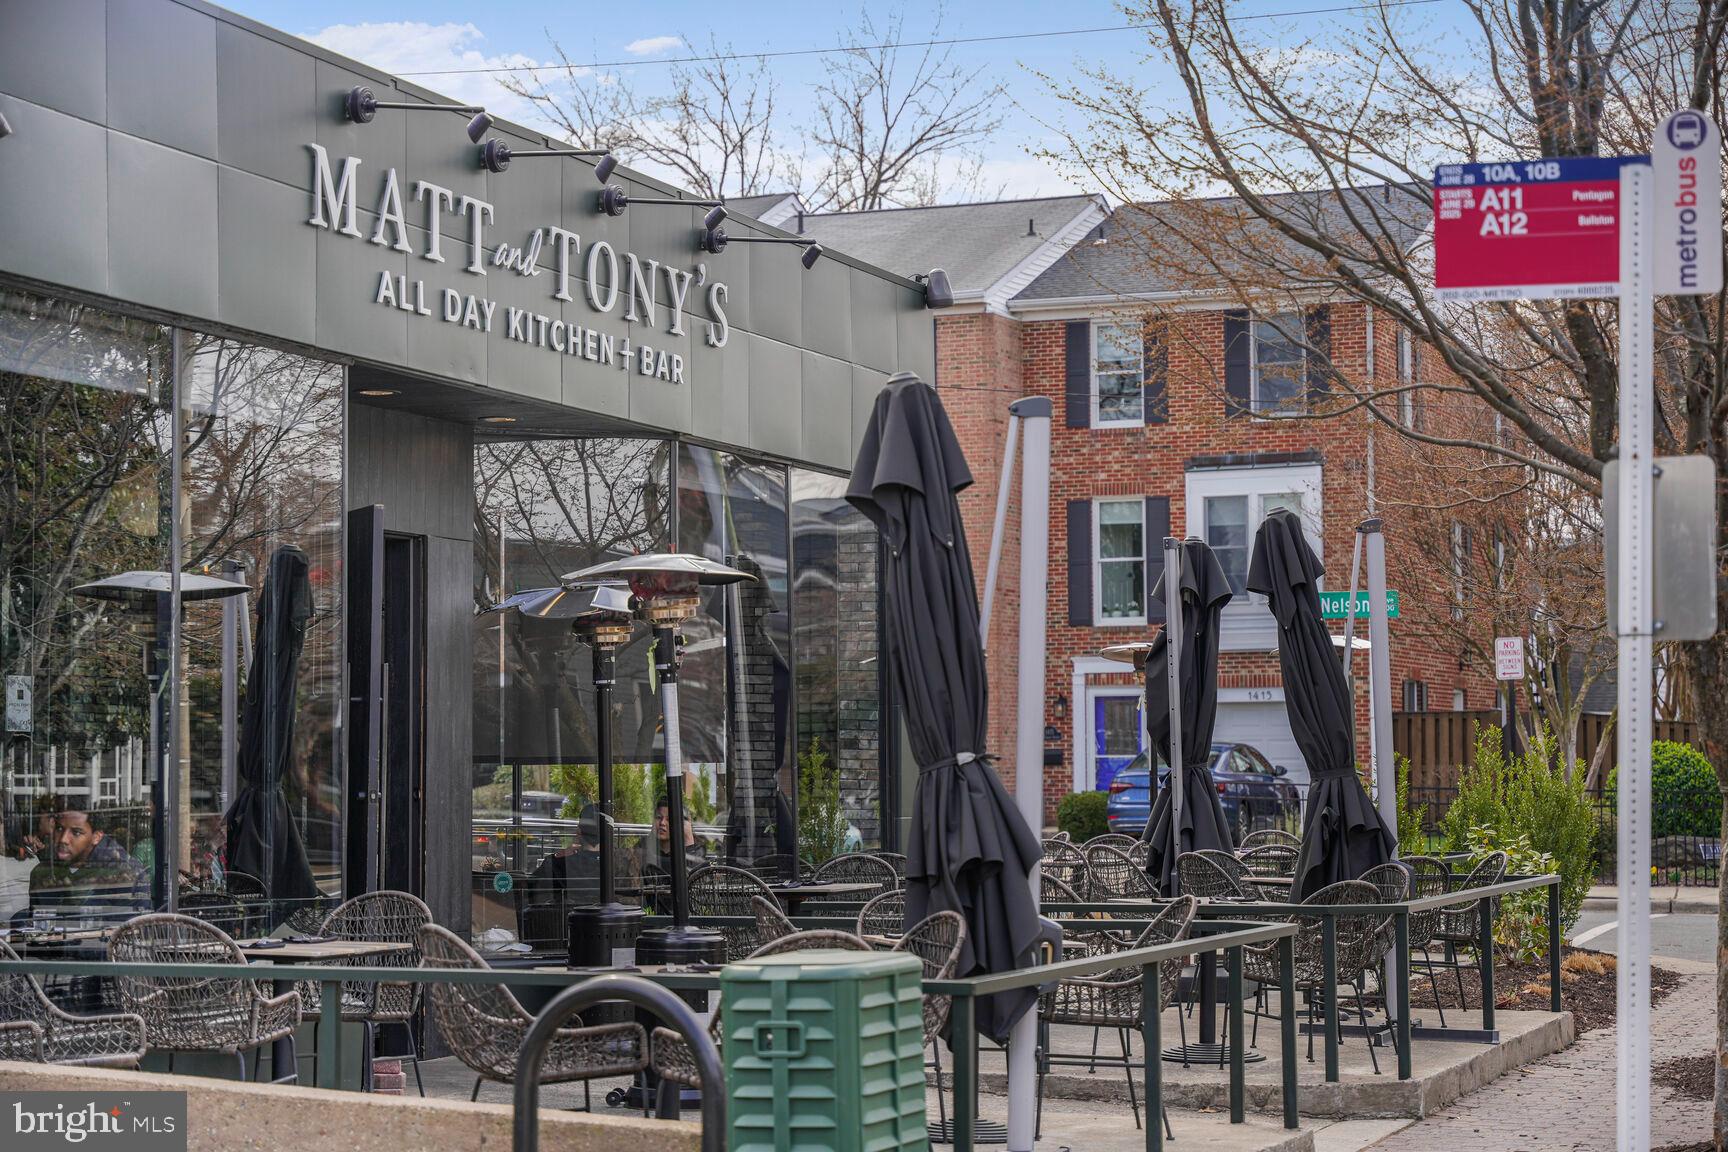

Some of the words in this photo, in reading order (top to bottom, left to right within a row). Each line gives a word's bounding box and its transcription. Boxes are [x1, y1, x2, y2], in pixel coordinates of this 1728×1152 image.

[1482, 164, 1521, 183] 10A,
[1525, 162, 1560, 180] 10B
[1480, 187, 1522, 211] A11
[1480, 211, 1528, 236] A12
[1675, 156, 1698, 288] metrobus
[309, 143, 494, 276] MATT
[493, 228, 543, 277] and
[549, 225, 729, 349] TONY'S
[377, 270, 432, 317] ALL
[444, 288, 496, 333] DAY
[508, 306, 615, 366] KITCHEN
[640, 345, 685, 385] BAR
[1321, 597, 1369, 613] Nelson
[1503, 641, 1515, 649] NO
